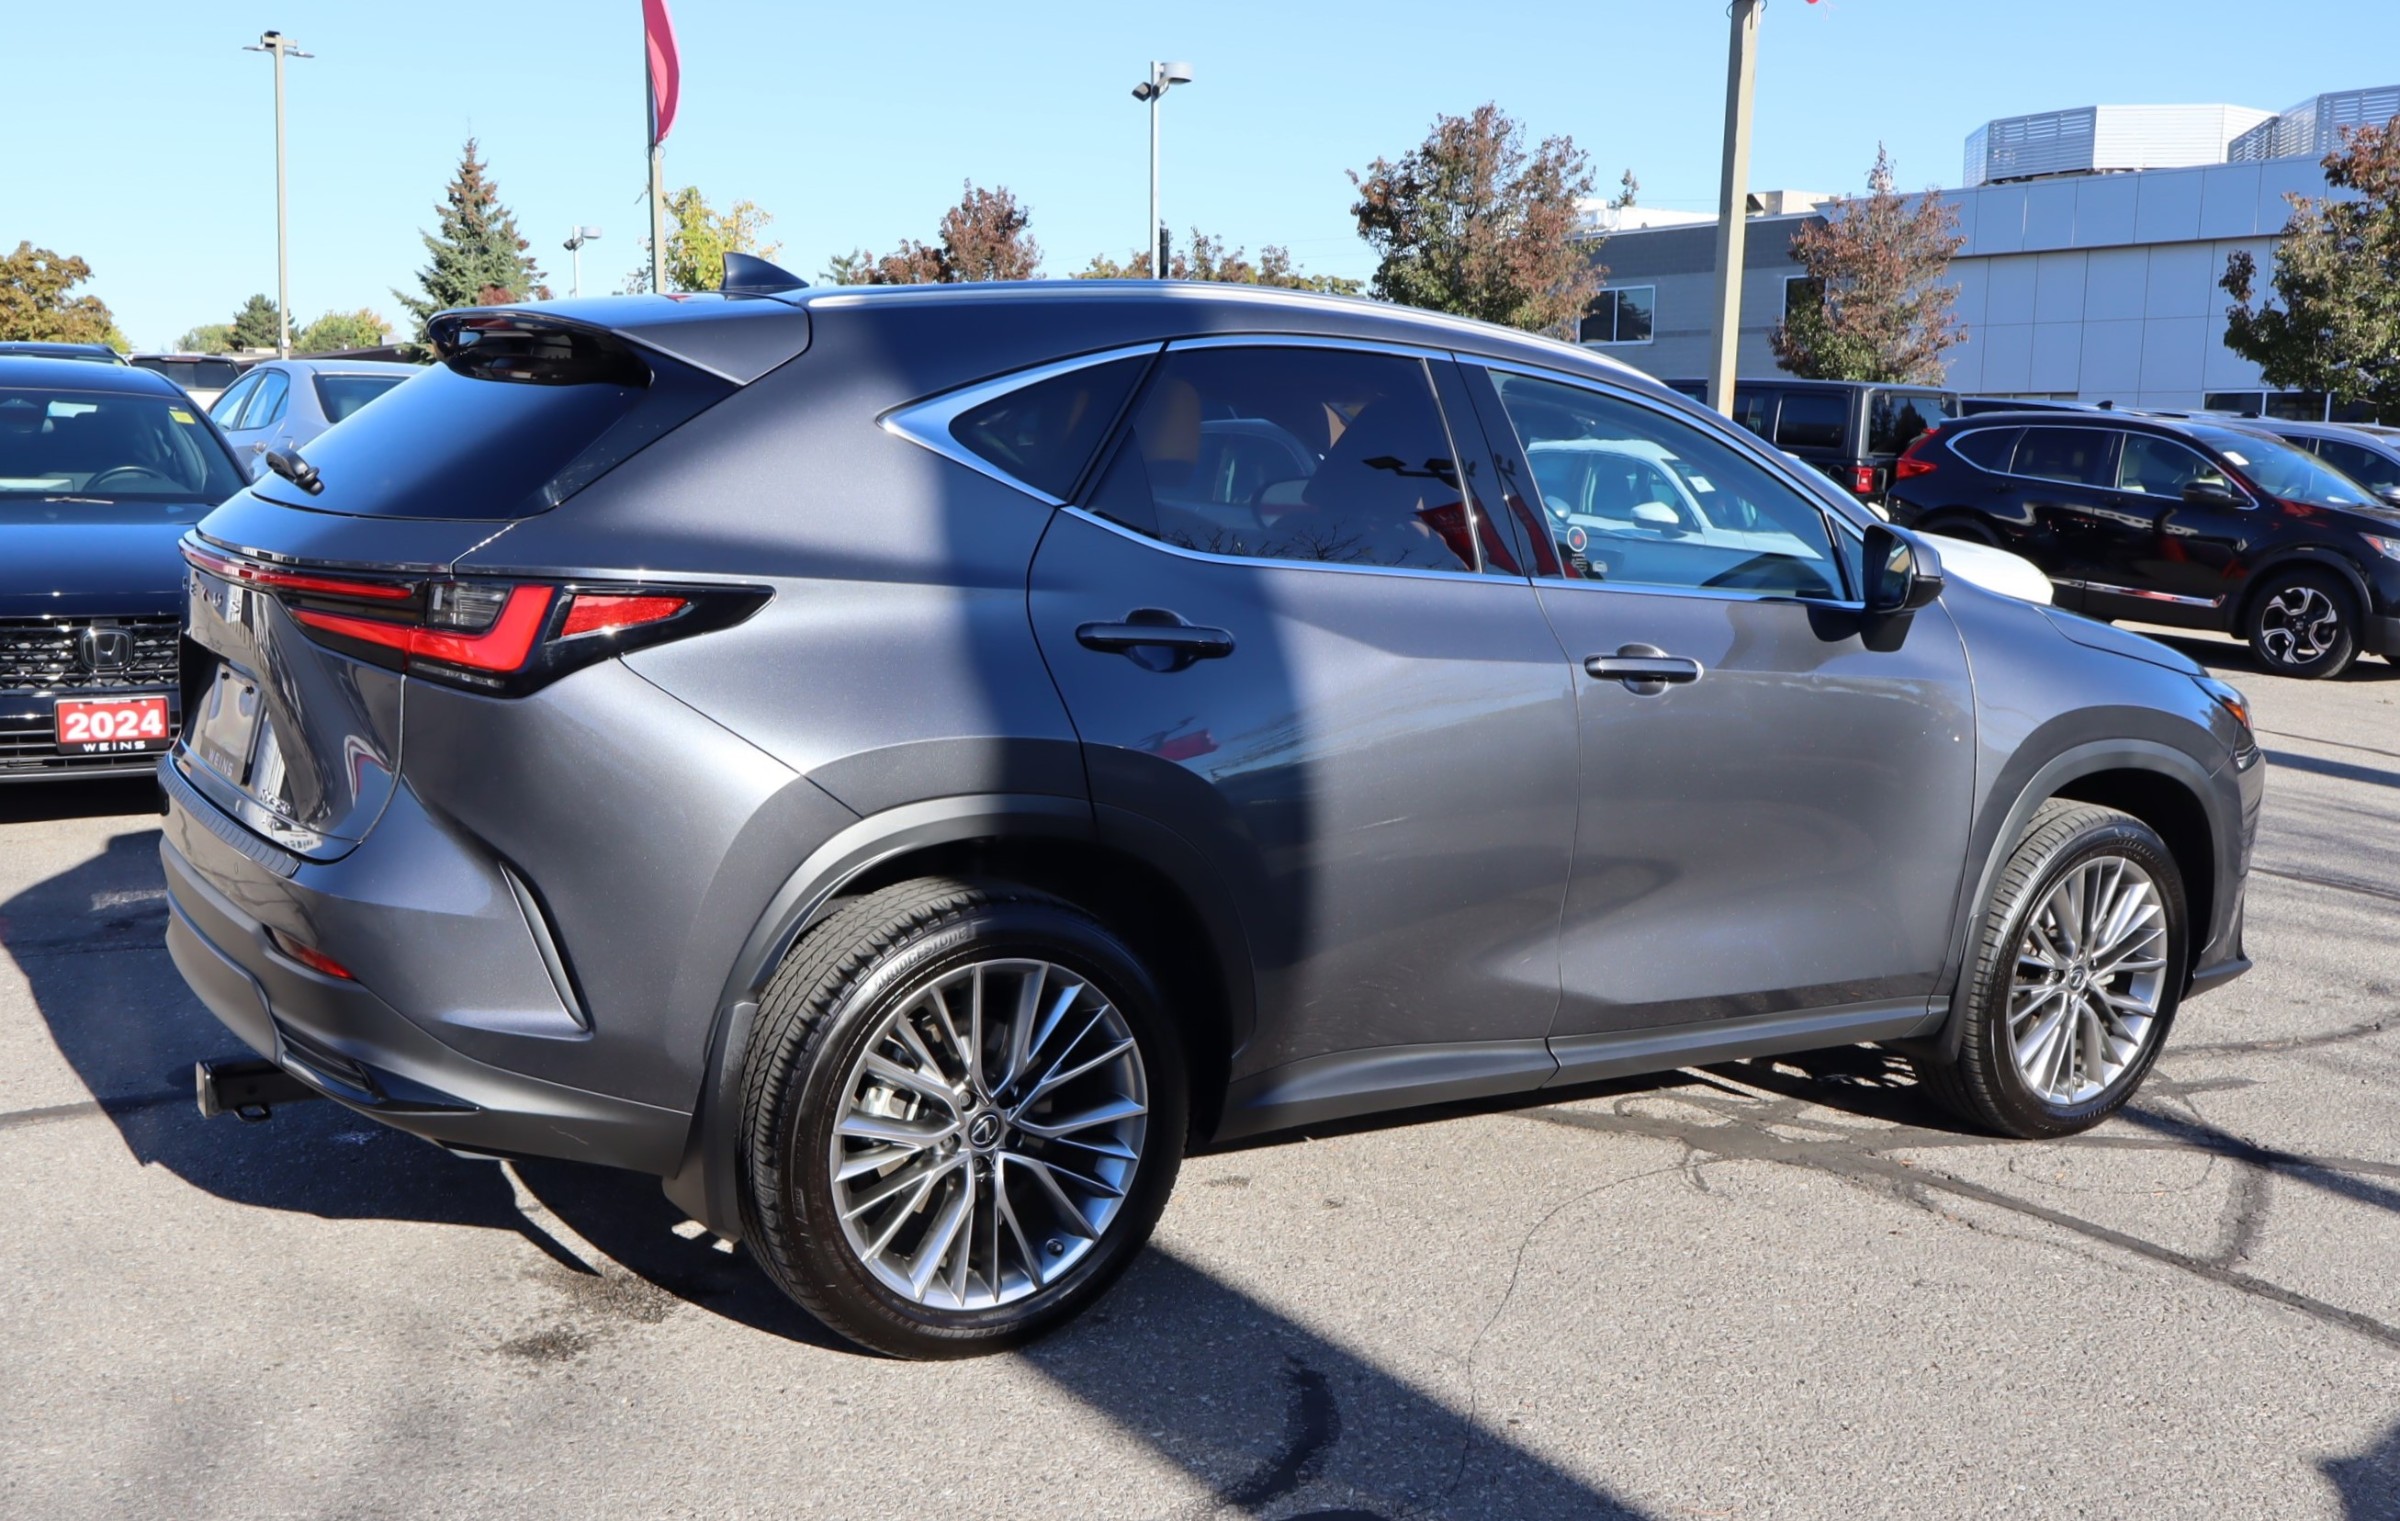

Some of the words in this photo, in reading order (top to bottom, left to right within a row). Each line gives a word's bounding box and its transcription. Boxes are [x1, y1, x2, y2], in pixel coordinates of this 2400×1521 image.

[65, 709, 163, 740] 2024
[83, 741, 145, 752] WEINS
[208, 747, 234, 777] WEINS
